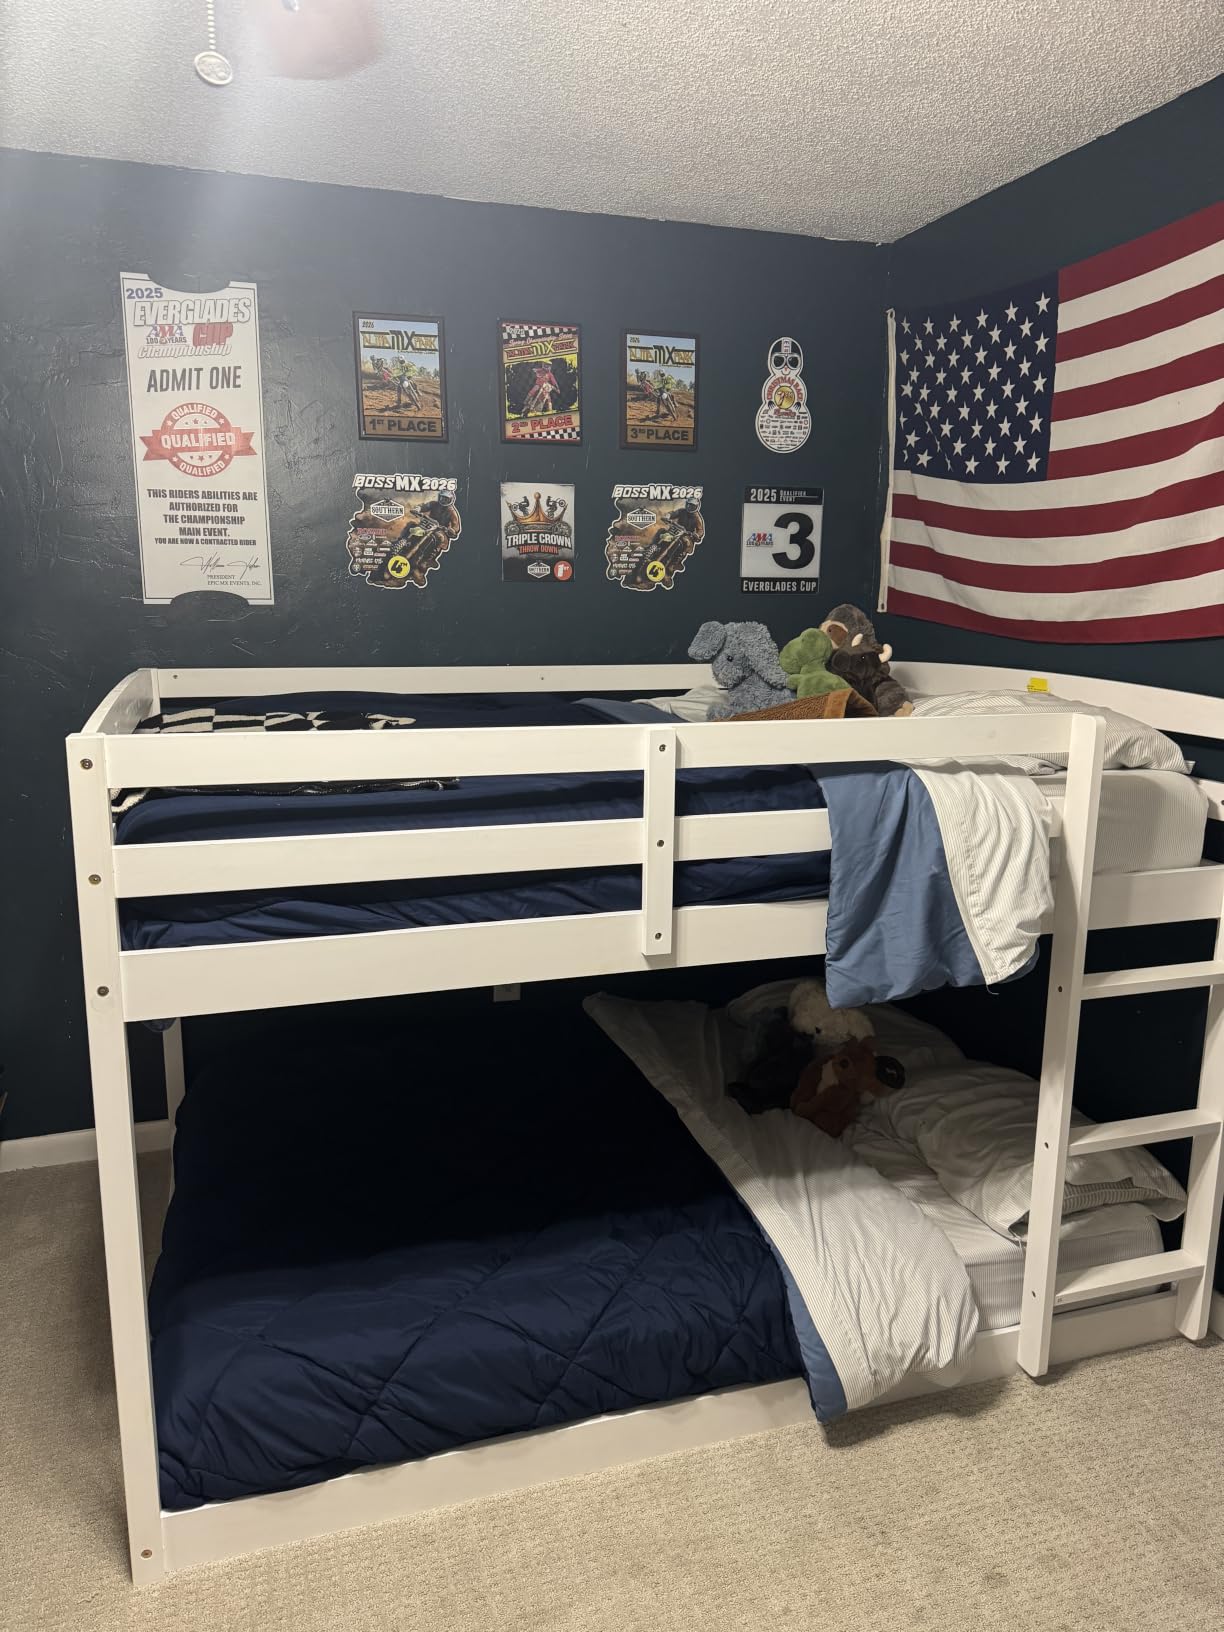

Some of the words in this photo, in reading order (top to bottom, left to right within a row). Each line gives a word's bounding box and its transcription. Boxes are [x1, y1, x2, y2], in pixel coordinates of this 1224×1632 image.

[126, 288, 163, 299] 2025
[133, 298, 251, 326] EVERGLADES
[148, 324, 184, 337] AMA
[138, 343, 232, 359] Championship
[146, 368, 204, 392] ADMIT
[209, 366, 242, 390] ONE
[172, 404, 218, 420] QUALIFIED
[387, 419, 436, 432] PLACE
[530, 415, 572, 430] PLACE
[160, 432, 236, 449] QUALIFIED
[646, 430, 688, 440] PLACE
[179, 460, 226, 476] QUALIFIED
[422, 479, 456, 490] 2026
[146, 488, 167, 499] THIS
[169, 489, 200, 499] RIDERS
[201, 490, 241, 500] ABILITIES
[242, 492, 258, 501] ARE
[672, 489, 702, 498] 2026
[750, 488, 776, 502] 2025
[169, 502, 220, 512] AUTHORIZED
[222, 503, 238, 513] FOR
[163, 514, 180, 524] THE
[181, 515, 245, 525] CHAMPIONSHIP
[179, 527, 201, 536] MAIN
[203, 527, 230, 537] EVENT.
[507, 533, 537, 547] TRIPLE
[539, 533, 572, 548] CROWN
[772, 512, 815, 569] 3
[519, 545, 539, 553] THROW
[540, 545, 558, 554] DOWN
[391, 559, 407, 574] 4TH
[649, 564, 663, 578] 4TH
[743, 580, 797, 591] EVERGLADES
[800, 581, 816, 591] CUP
